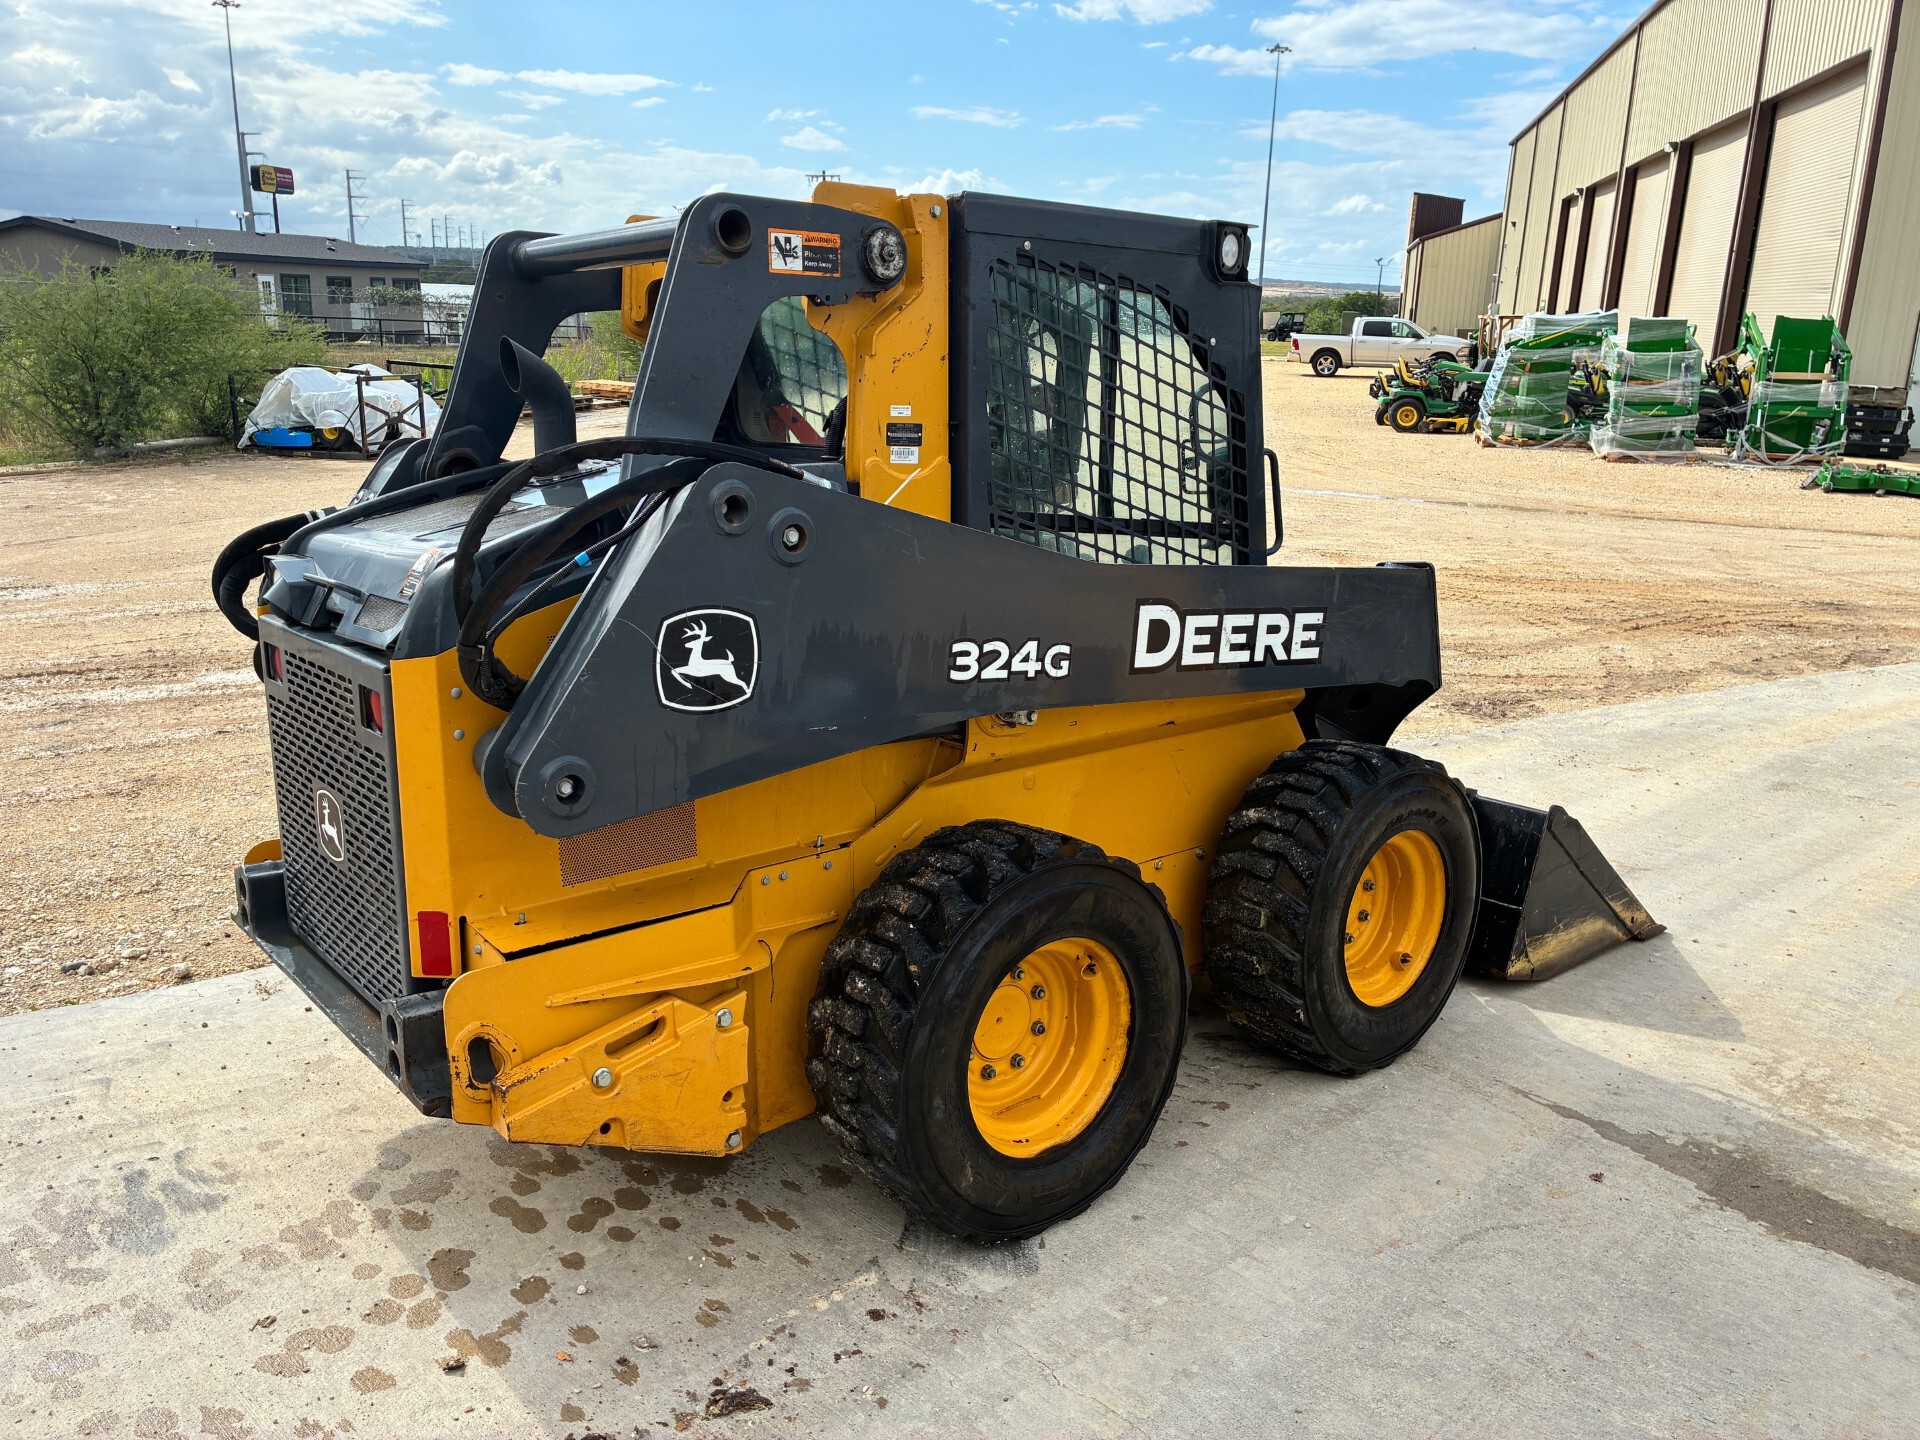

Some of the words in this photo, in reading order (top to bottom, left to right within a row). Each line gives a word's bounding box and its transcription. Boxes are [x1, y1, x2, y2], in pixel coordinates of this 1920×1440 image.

[811, 236, 838, 245] WARNING
[804, 260, 818, 268] Keep
[818, 261, 832, 269] Away
[1134, 604, 1324, 669] DEERE
[949, 640, 1071, 682] 324G
